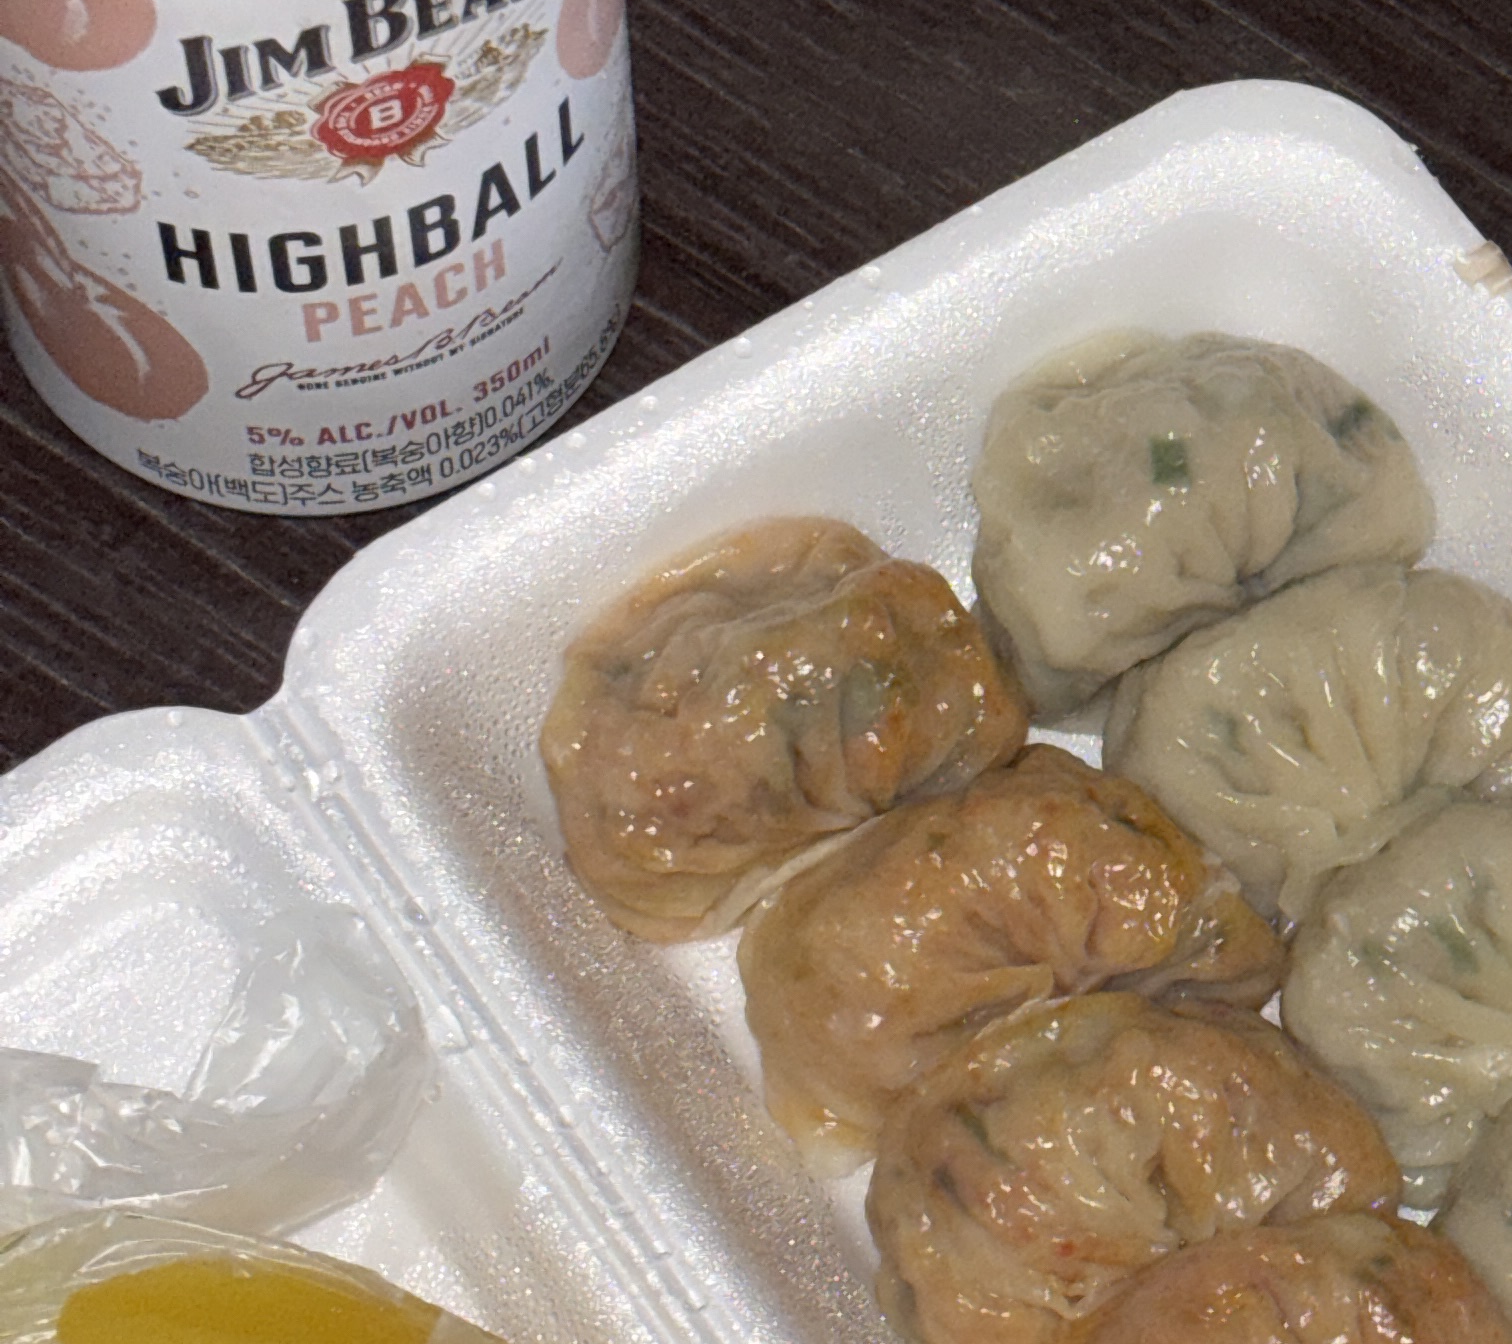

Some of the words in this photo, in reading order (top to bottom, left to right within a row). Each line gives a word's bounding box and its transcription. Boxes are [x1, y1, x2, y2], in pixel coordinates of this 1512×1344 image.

[155, 22, 334, 116] JIM
[368, 99, 403, 130] B
[155, 97, 586, 294] HIGHBALL
[301, 238, 507, 343] PEACH
[247, 426, 305, 446] 5%
[472, 335, 551, 403] 350ml
[353, 465, 433, 502] 농축액
